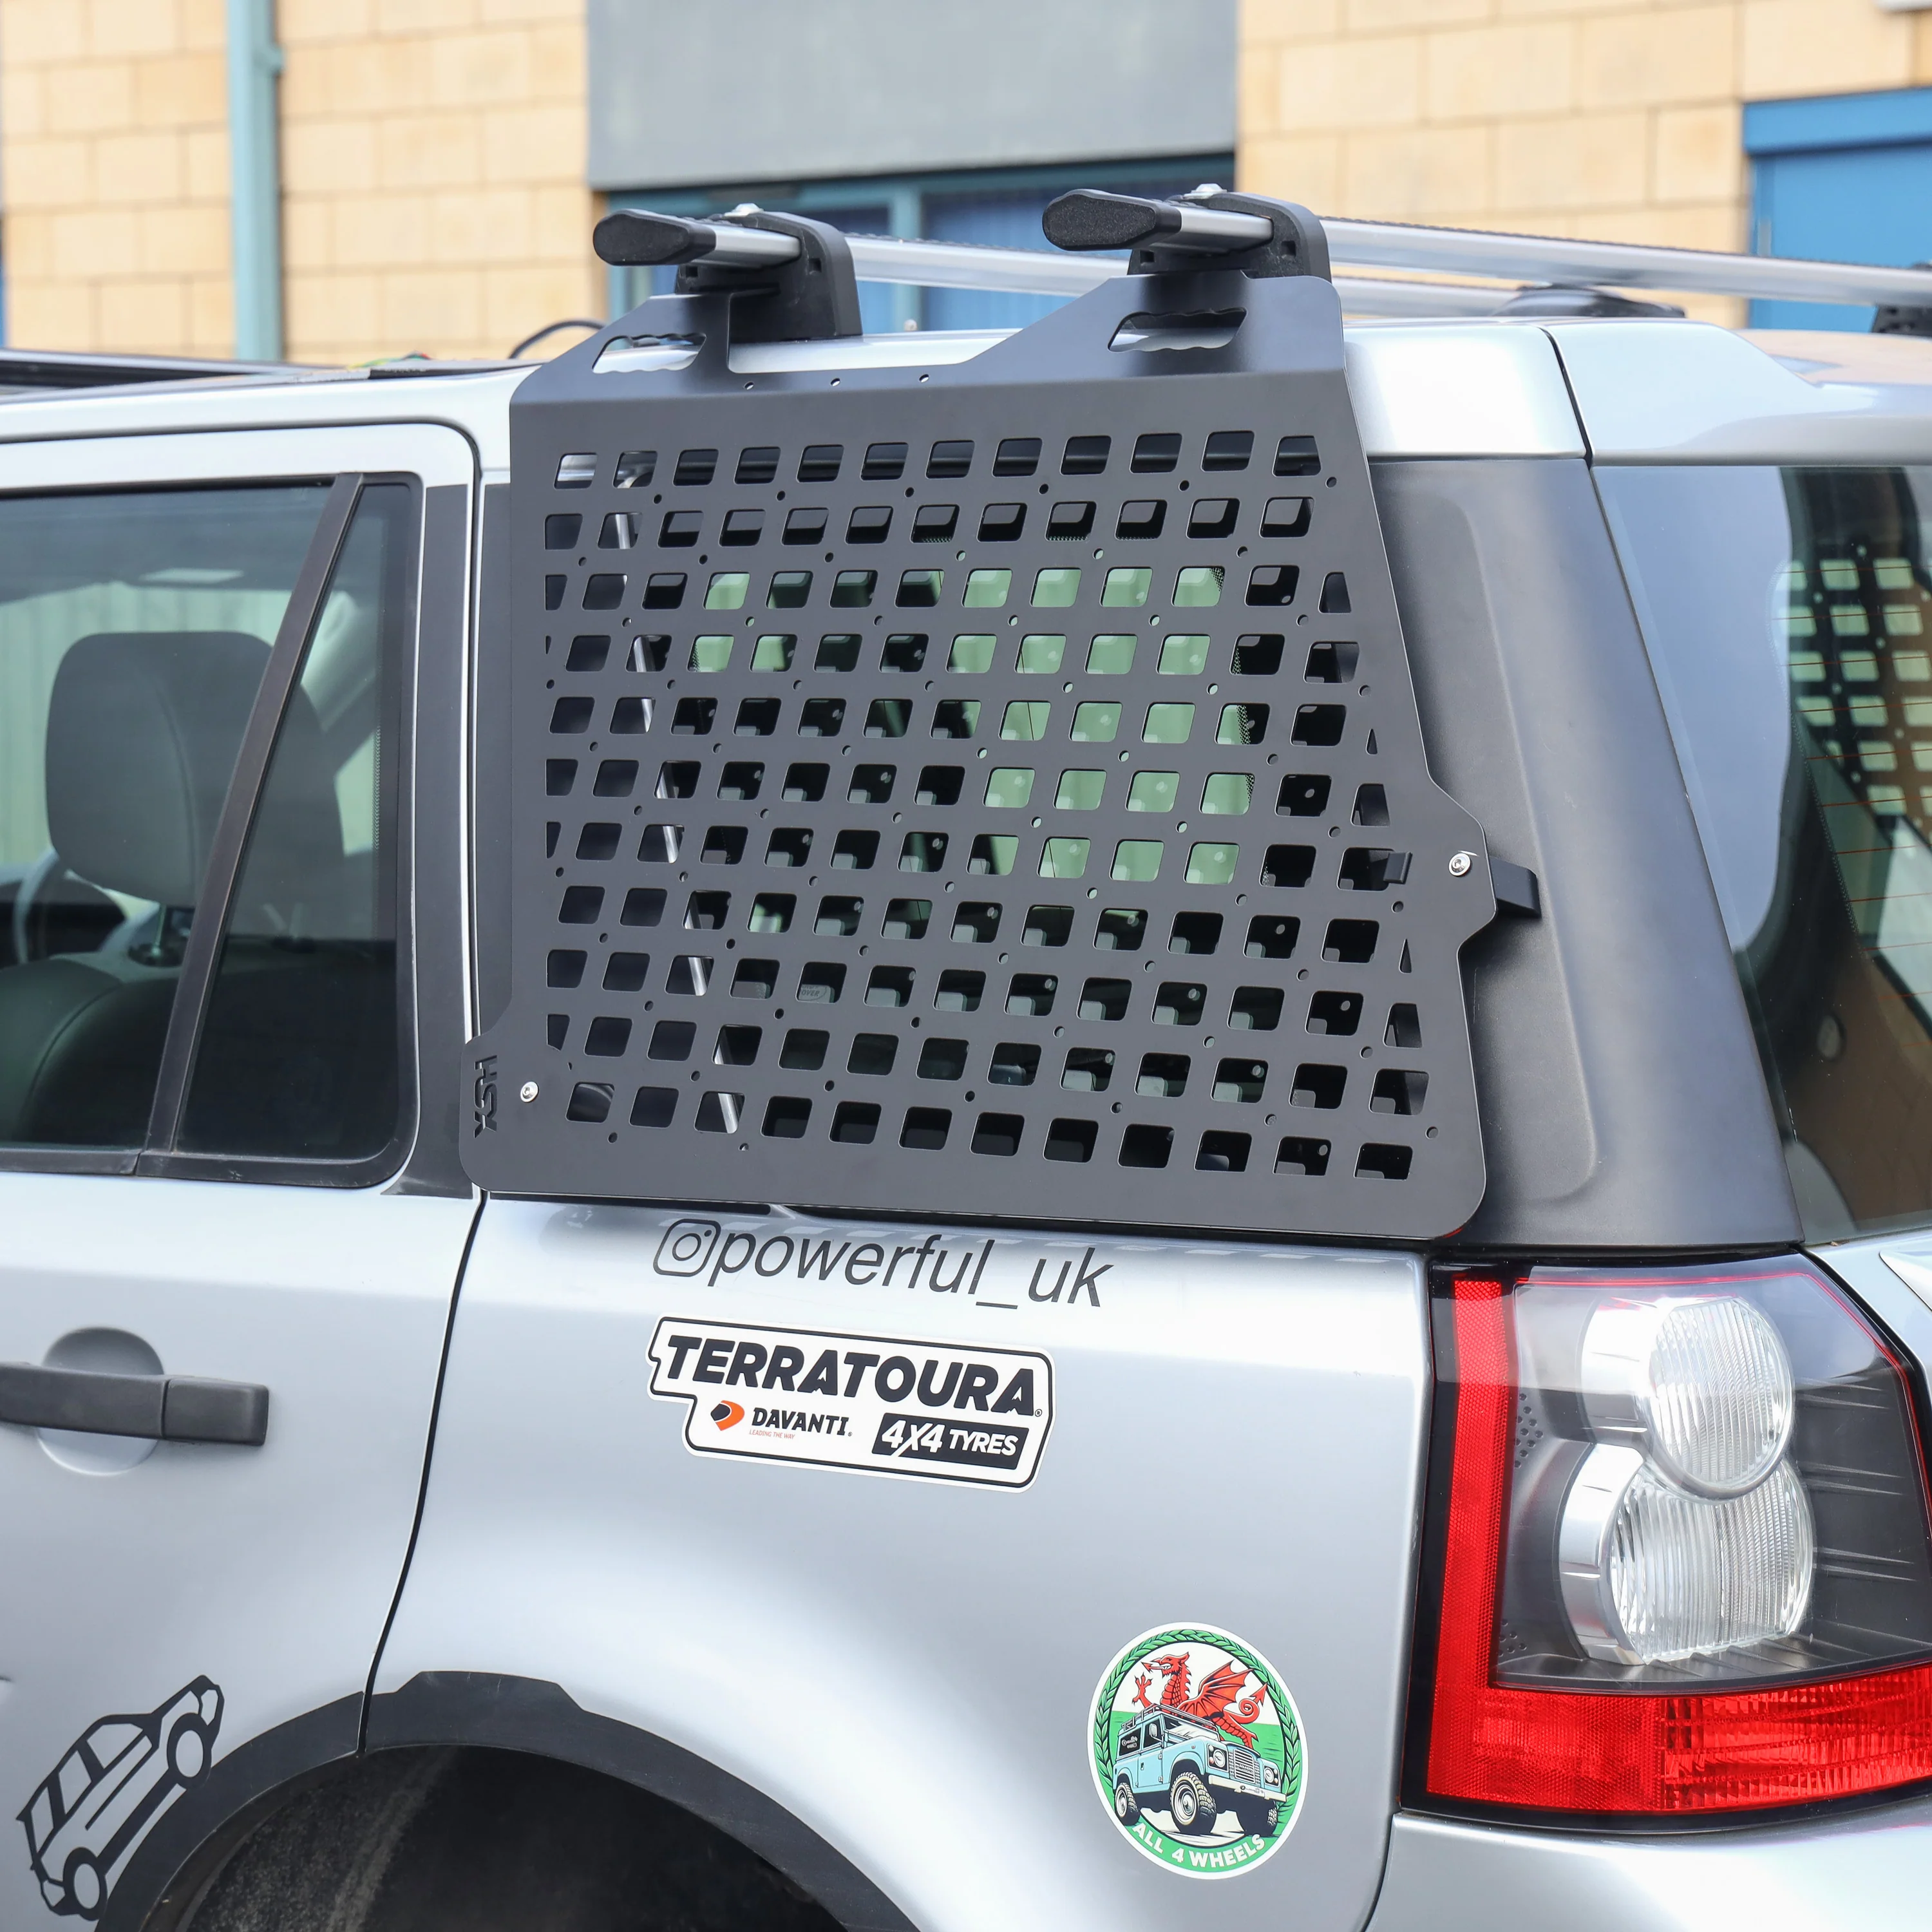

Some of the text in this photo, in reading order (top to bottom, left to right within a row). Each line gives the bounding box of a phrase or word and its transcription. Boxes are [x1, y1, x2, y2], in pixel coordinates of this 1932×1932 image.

[667, 1334, 1034, 1416] TERRATOURA
[749, 1429, 772, 1437] LEADING
[752, 1407, 849, 1436] DAVANTI
[949, 1428, 1019, 1456] TYRES
[1132, 1823, 1265, 1868] ALL 4 WHEELS
